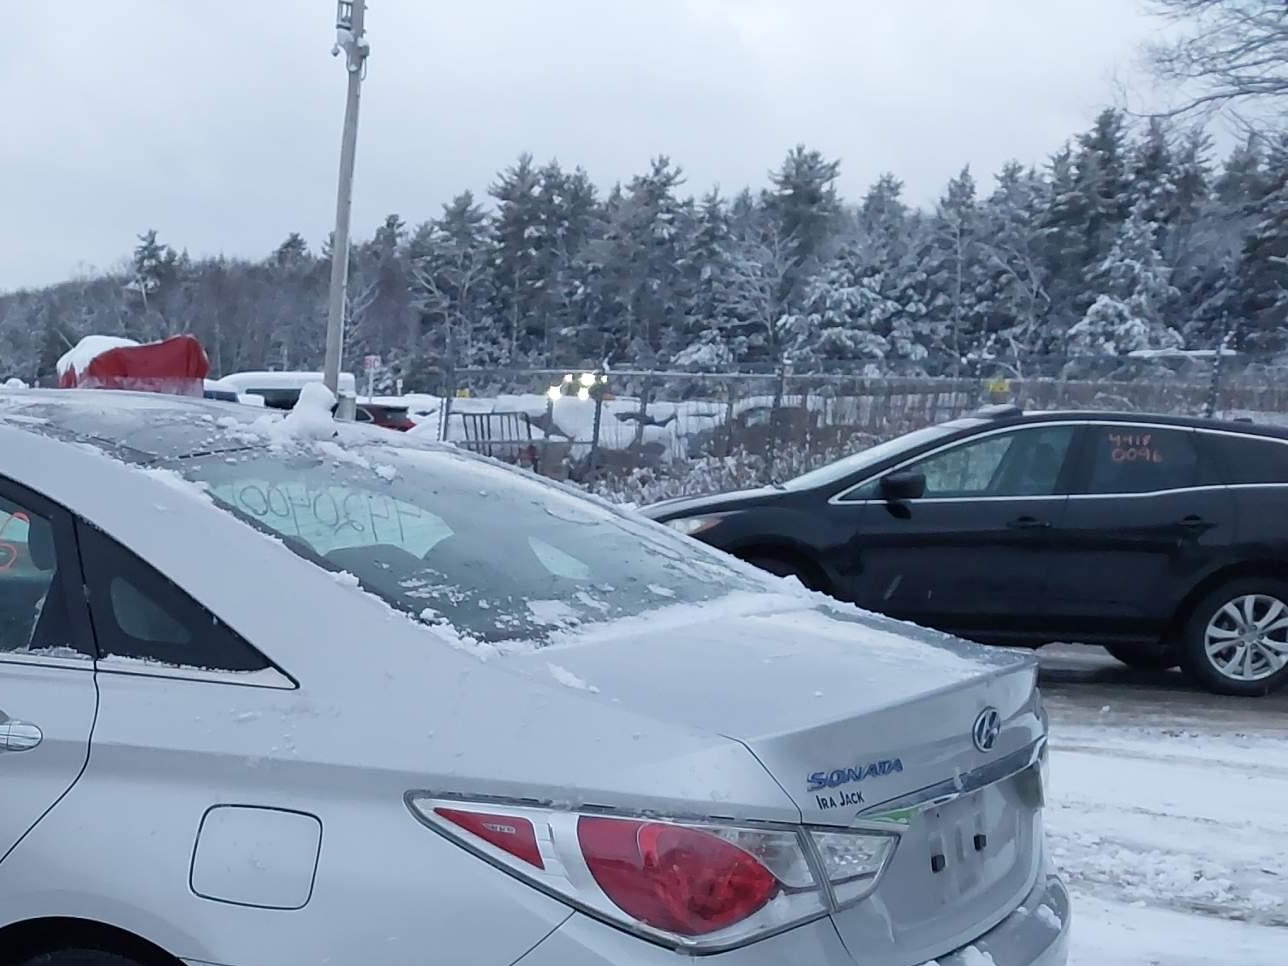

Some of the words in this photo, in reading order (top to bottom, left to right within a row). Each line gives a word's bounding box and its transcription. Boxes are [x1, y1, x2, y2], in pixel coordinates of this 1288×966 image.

[807, 758, 904, 792] SONATA
[815, 794, 837, 810] IRA
[840, 790, 864, 806] JACK
